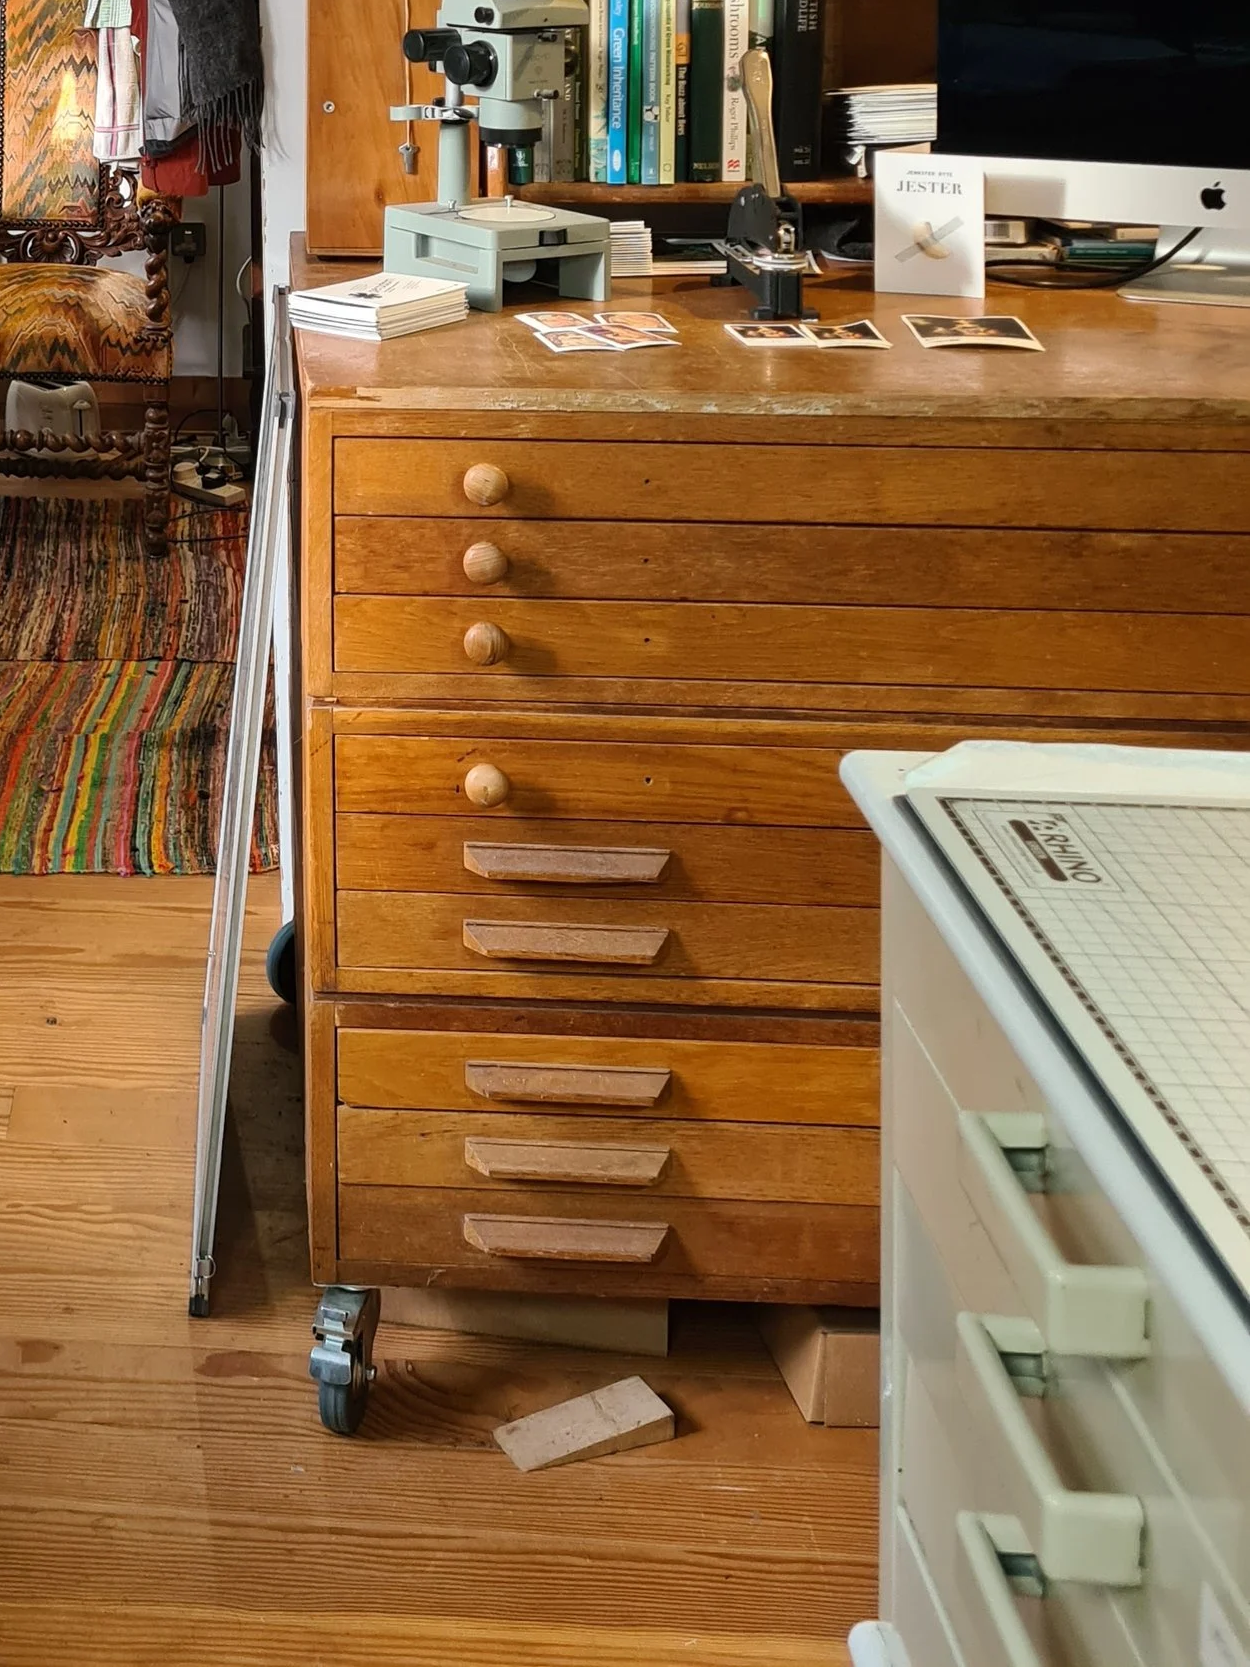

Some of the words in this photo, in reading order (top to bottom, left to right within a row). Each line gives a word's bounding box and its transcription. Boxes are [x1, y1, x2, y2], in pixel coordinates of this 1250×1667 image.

[613, 27, 625, 63] Green
[678, 66, 687, 80] The
[612, 66, 624, 129] Inheritance
[678, 81, 686, 97] Buzz
[678, 98, 686, 117] about
[729, 97, 739, 121] Roger
[677, 119, 686, 136] Bees
[728, 122, 739, 151] Phillips
[896, 180, 963, 195] JESTER
[1039, 834, 1102, 883] RHINO
